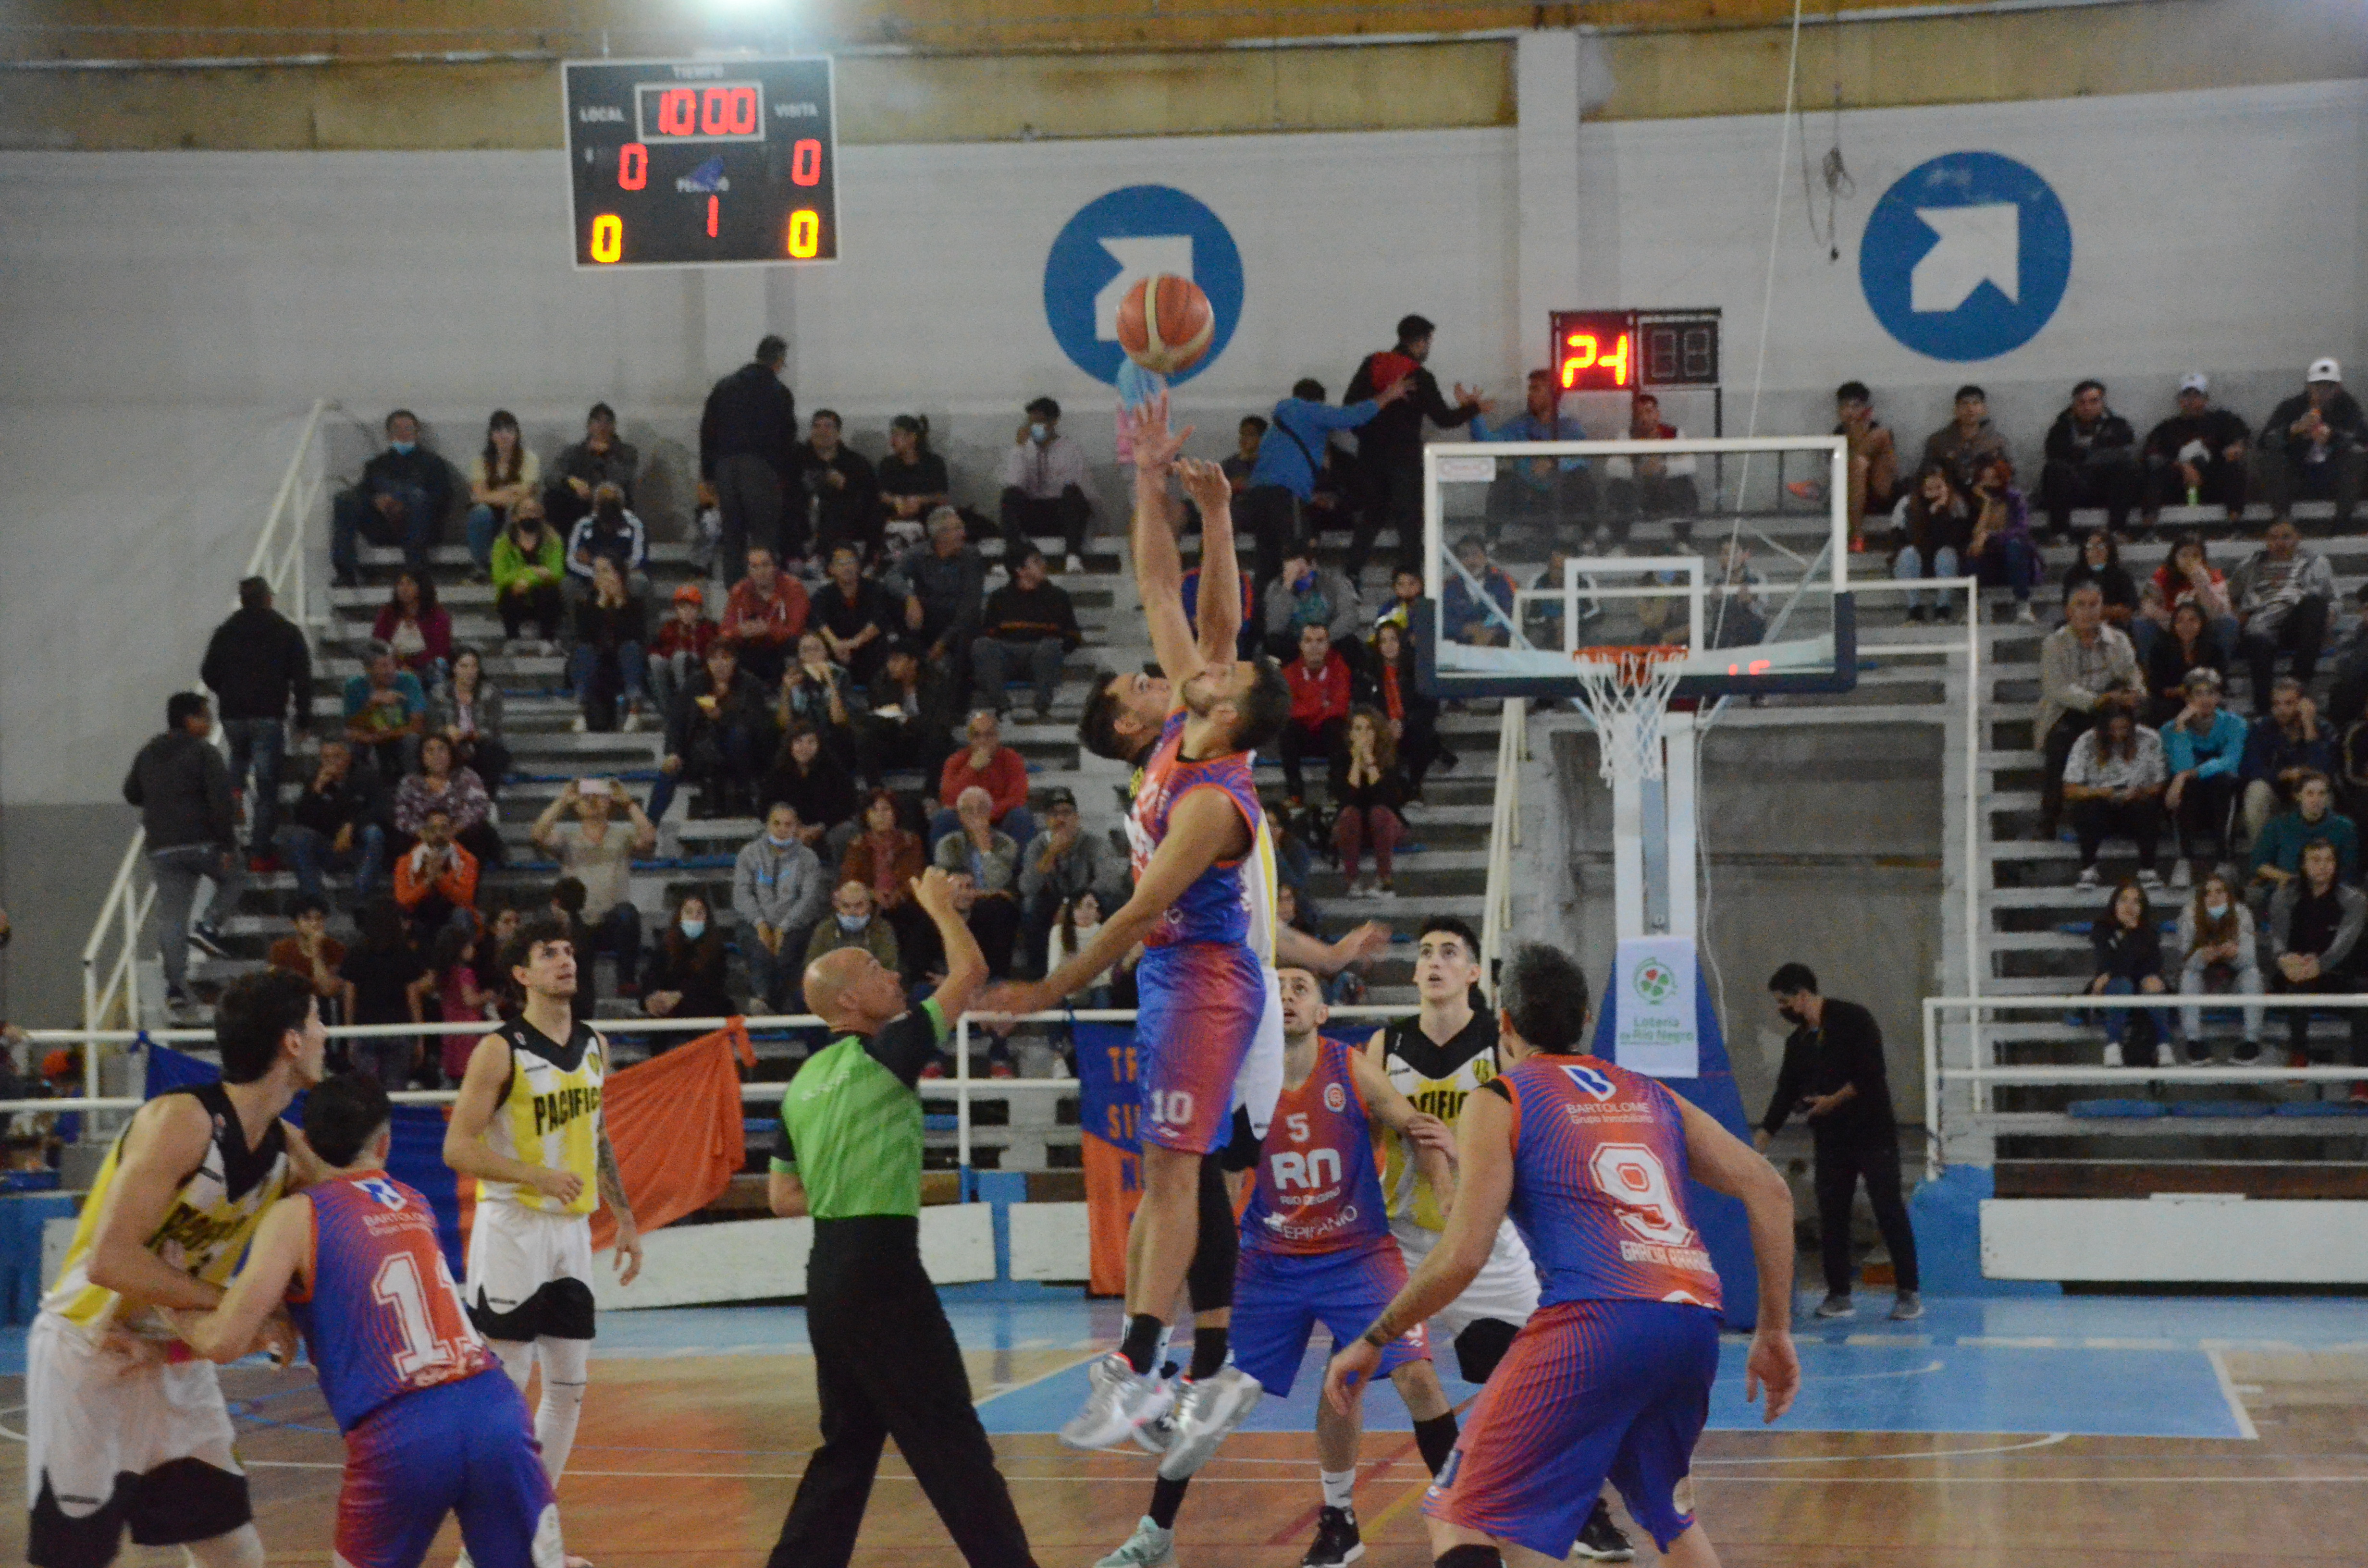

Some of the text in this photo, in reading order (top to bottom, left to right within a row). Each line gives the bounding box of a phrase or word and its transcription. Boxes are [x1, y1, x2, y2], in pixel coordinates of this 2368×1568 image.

[618, 143, 648, 190] 0
[791, 138, 821, 186] 0
[592, 214, 622, 263] 0
[707, 195, 718, 237] 1
[788, 209, 819, 258] 0
[1562, 335, 1628, 388] 24
[1150, 1090, 1193, 1125] 10
[1286, 1113, 1310, 1142] 5
[1588, 1142, 1697, 1248] 9
